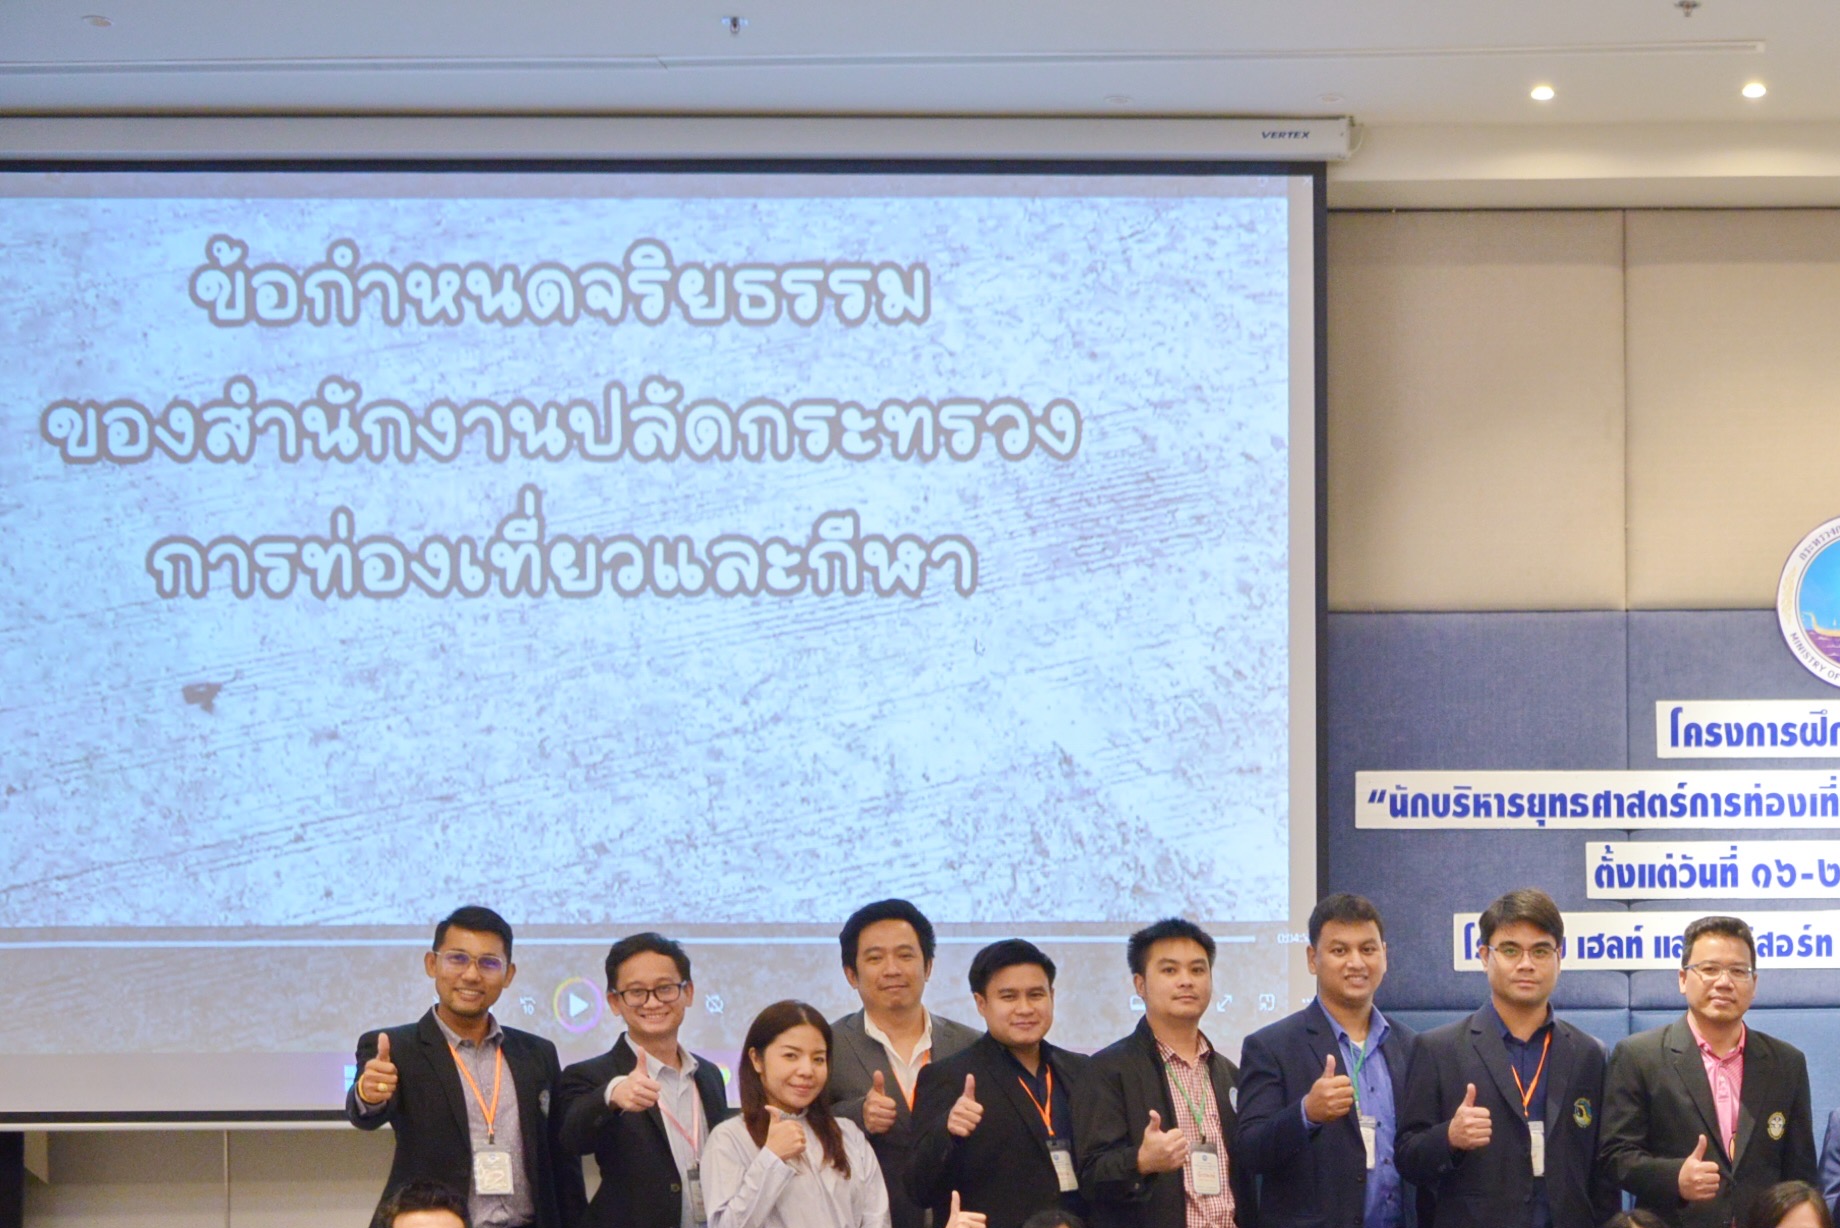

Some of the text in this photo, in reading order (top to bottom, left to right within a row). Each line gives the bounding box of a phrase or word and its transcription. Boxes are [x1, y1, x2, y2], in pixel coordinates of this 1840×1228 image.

[1261, 131, 1310, 139] VERTEX
[191, 237, 930, 324] ข้อกำหนดจริยธรรม
[42, 375, 1080, 462] ของสำนักงานปลัดกระทรวง
[149, 485, 978, 598] การท่องเที่ยวและกีฬา
[1790, 632, 1830, 673] MINISTRY
[1827, 669, 1840, 680] OF
[1594, 845, 1739, 889] ตั้งแต่วันที่
[1577, 925, 1643, 959] เฮลท์
[1750, 925, 1833, 958] สอร์ท
